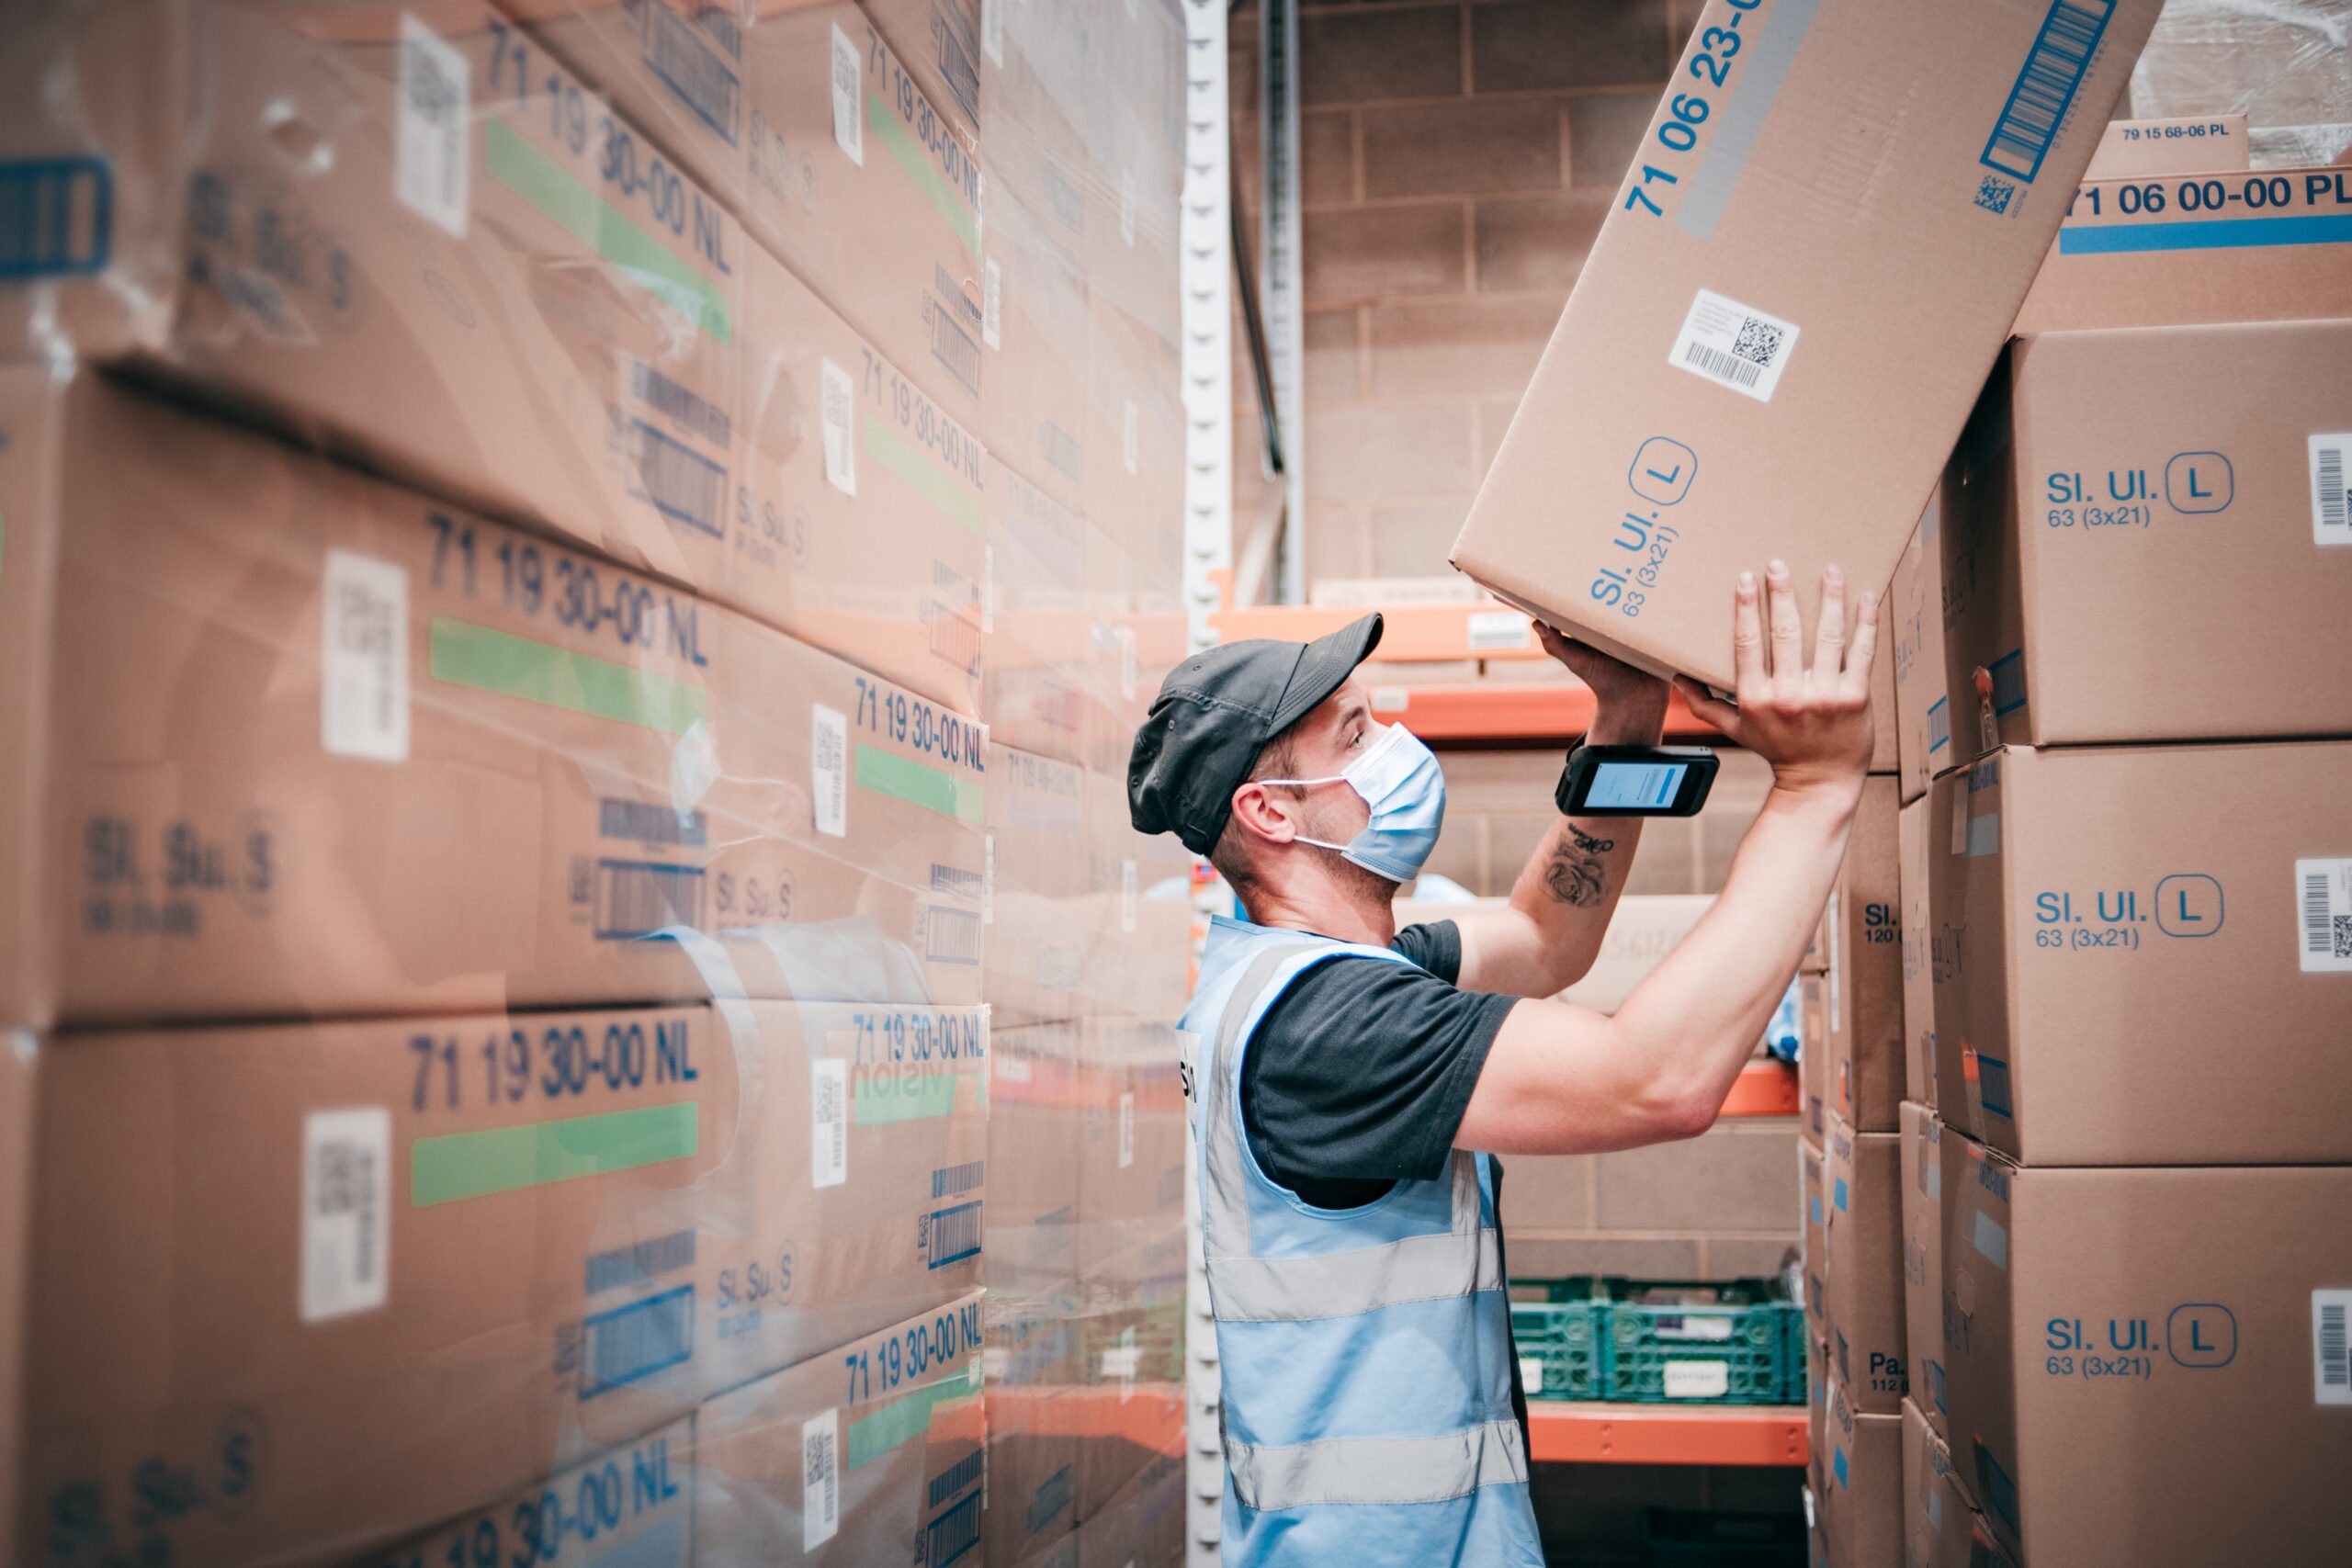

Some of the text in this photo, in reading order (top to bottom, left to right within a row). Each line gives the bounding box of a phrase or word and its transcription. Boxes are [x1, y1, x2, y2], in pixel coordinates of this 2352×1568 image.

[867, 25, 886, 90] 71
[894, 66, 912, 123] 19
[918, 96, 959, 185] 30-00
[489, 18, 527, 112] 71
[546, 75, 585, 156] 19
[599, 117, 685, 236] 30-00
[695, 194, 731, 276] NL
[2122, 124, 2230, 140] 79 15 68-06 PL
[1624, 164, 1678, 218] 71
[1658, 94, 1709, 152] 06
[2119, 183, 2165, 214] 06
[2178, 176, 2291, 210] 00-00
[2305, 174, 2352, 205] PL
[861, 346, 984, 492] 71 19 30-00 NL
[1645, 464, 1681, 485] L
[2189, 467, 2212, 498] L
[2048, 505, 2150, 530] 63 (3x21)
[427, 512, 707, 666] 71 19 30-00 NL
[1622, 526, 1679, 618] 63 (3x21)
[855, 676, 985, 773] 71 19 30-00 NL
[2179, 890, 2202, 921] L
[1867, 929, 1894, 943] 120
[2036, 928, 2140, 951] 63 (3x21)
[853, 1013, 875, 1064] 71
[883, 1013, 904, 1062] 19
[911, 1013, 958, 1061] 30-00
[964, 1013, 985, 1058] NL
[409, 1020, 699, 1113] 71 19 30-00 NL
[845, 1349, 868, 1406] 71
[878, 1337, 901, 1391] 19
[907, 1313, 956, 1378] 30-00
[960, 1302, 982, 1352] NL
[2190, 1319, 2215, 1351] L
[1870, 1352, 1905, 1375] Pa.
[2046, 1356, 2151, 1380] 63 (3x21)
[1871, 1379, 1897, 1392] 112
[512, 1462, 623, 1568] 30-00
[634, 1438, 678, 1514] NL
